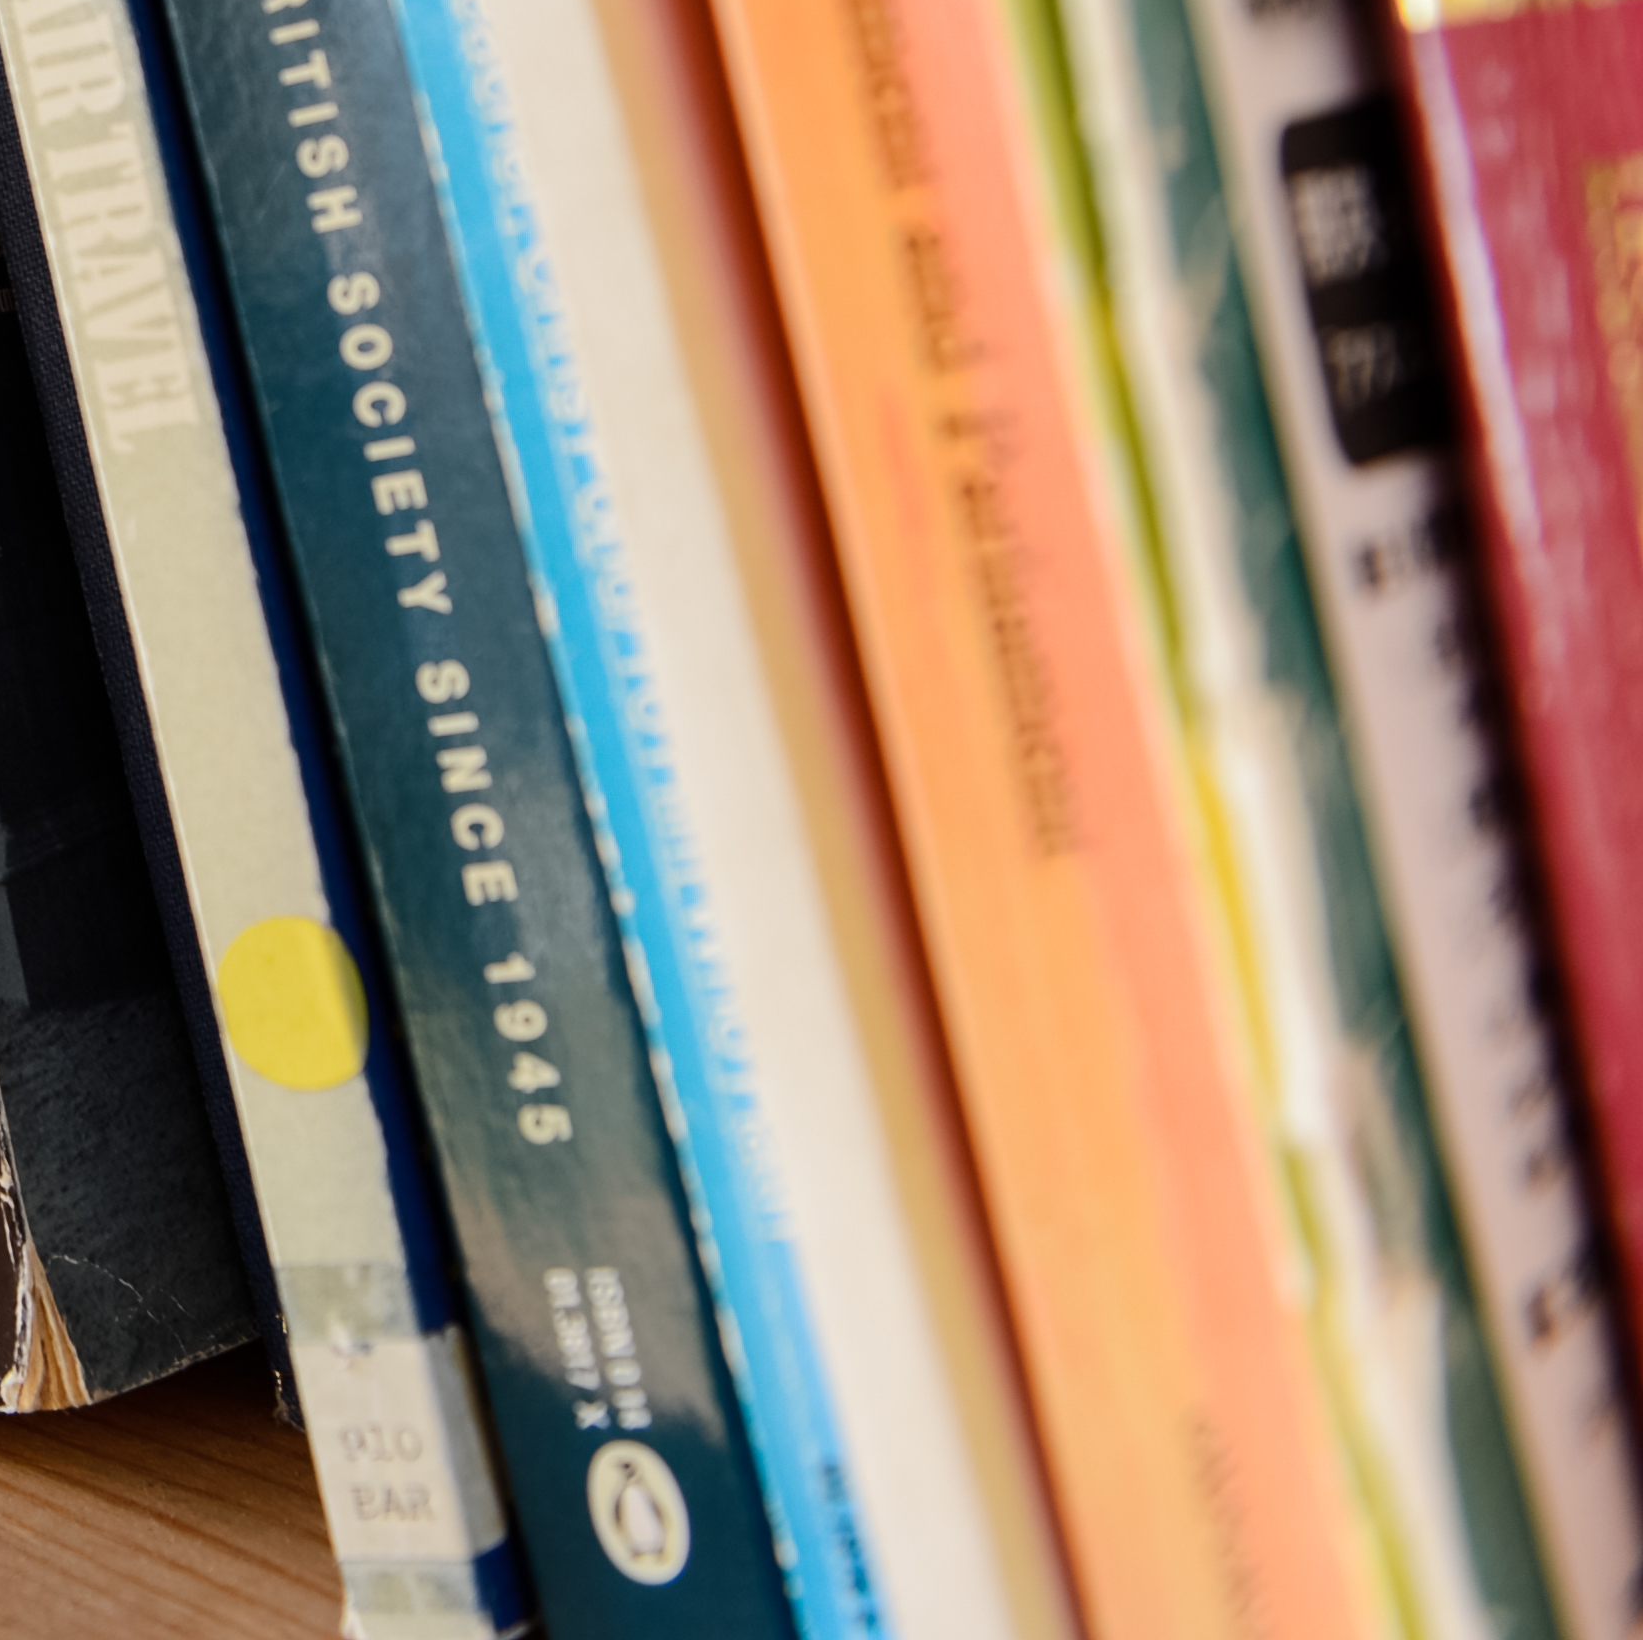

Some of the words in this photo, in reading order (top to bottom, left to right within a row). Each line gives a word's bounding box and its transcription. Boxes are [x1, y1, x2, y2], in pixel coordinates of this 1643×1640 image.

[44, 122, 201, 455] TRAVEL
[326, 271, 455, 615] SOCIETY
[414, 657, 519, 906] SINCE
[483, 952, 573, 1145] 1945
[351, 1486, 434, 1522] BAR
